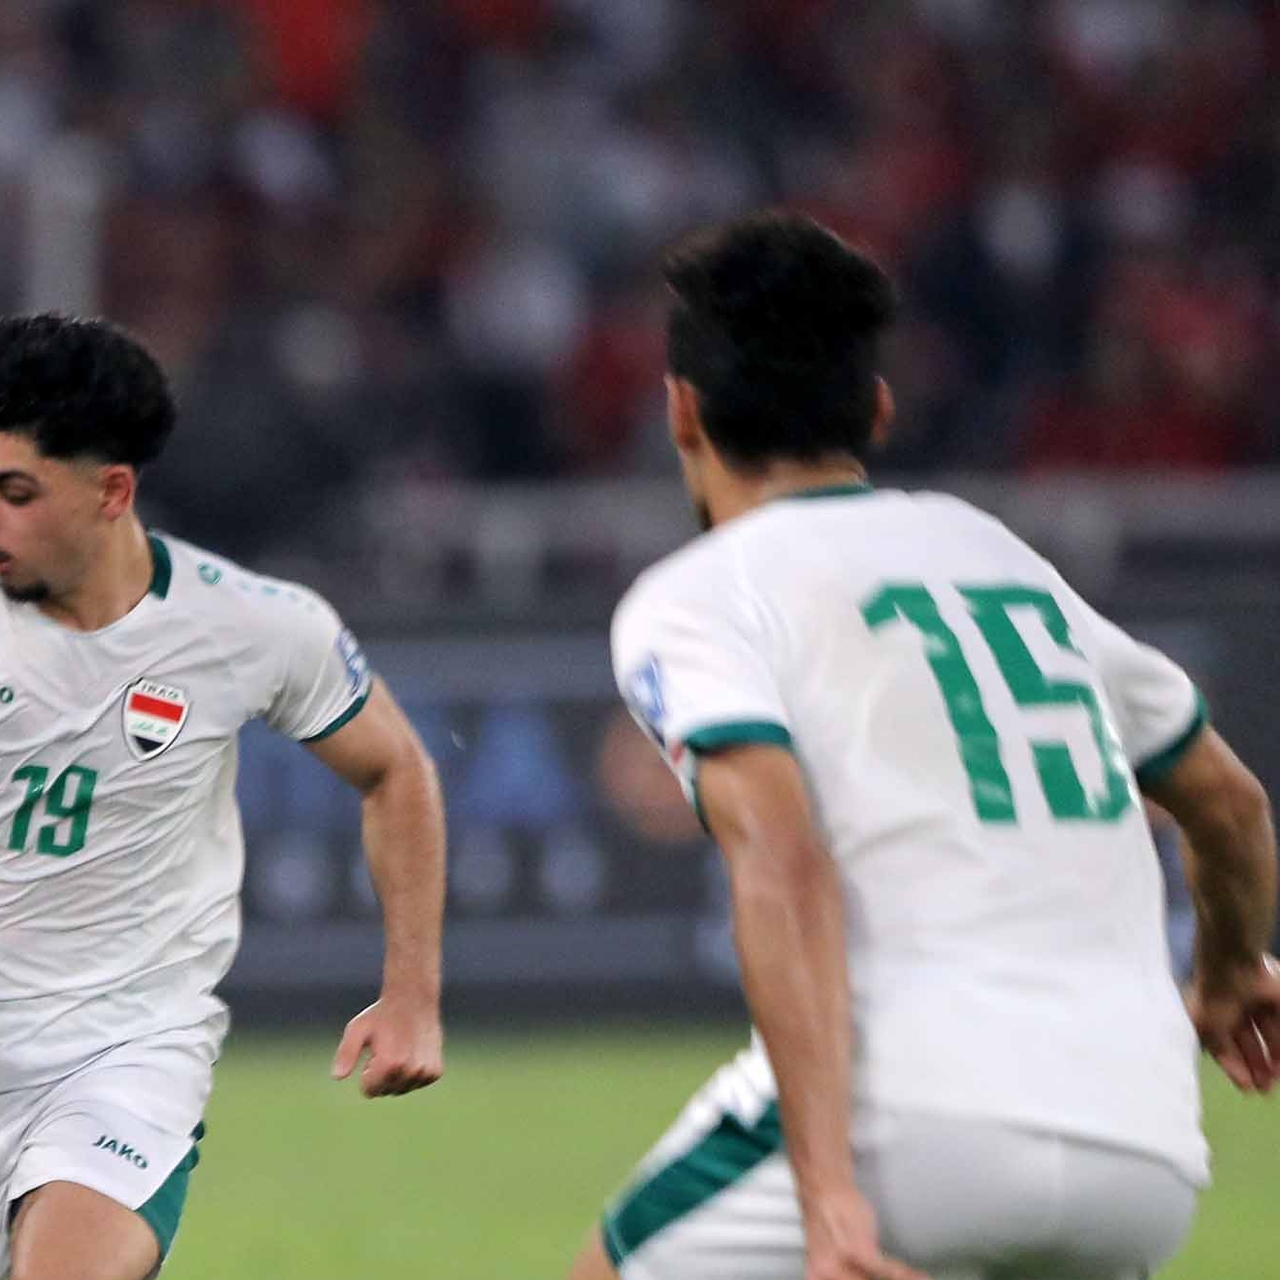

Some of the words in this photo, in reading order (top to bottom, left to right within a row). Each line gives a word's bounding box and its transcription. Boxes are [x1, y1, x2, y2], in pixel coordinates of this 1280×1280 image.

[858, 581, 1138, 826] 15
[7, 764, 98, 857] 19
[92, 1134, 148, 1169] JAKO
